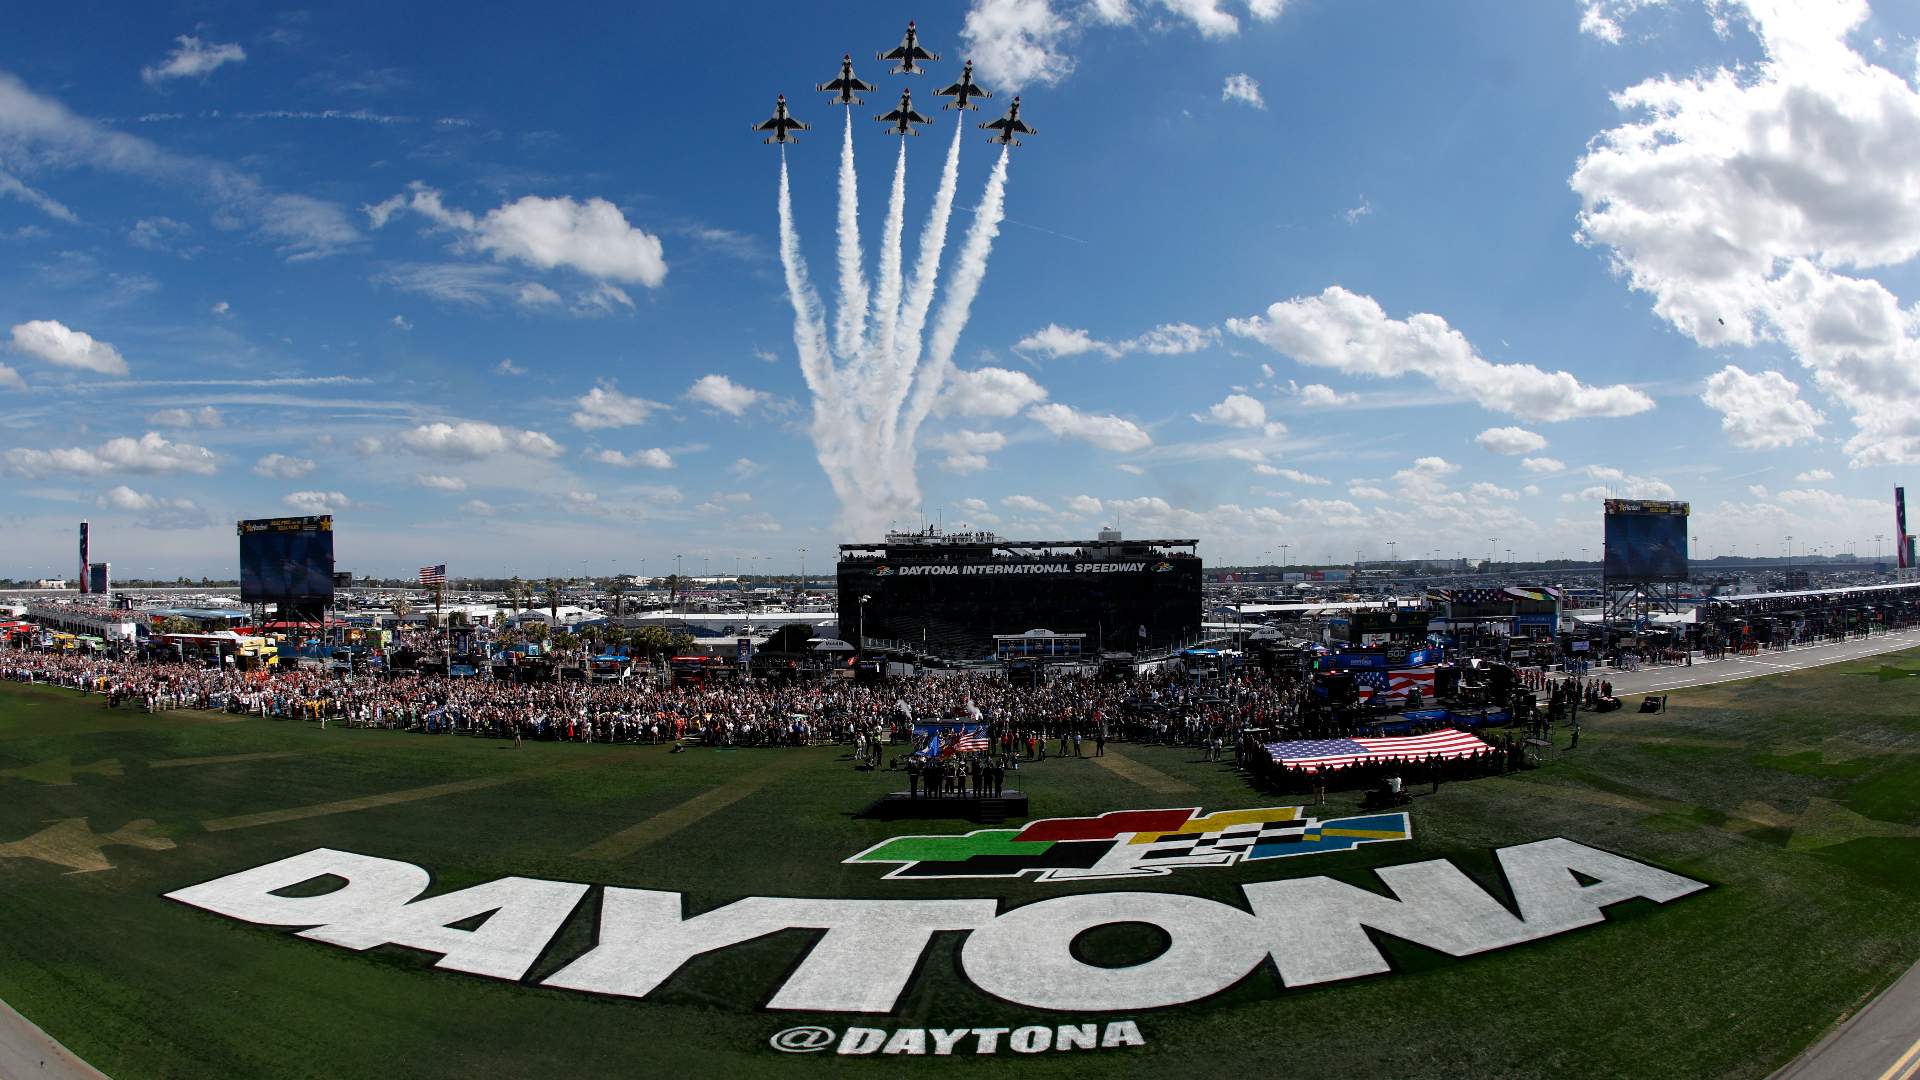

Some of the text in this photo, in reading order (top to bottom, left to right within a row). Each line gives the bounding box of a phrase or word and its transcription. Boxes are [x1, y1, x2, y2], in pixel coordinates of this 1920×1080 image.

[899, 562, 1146, 576] DAYTONA INTERNATIONAL SPEEDWAY
[164, 838, 1708, 1013] DAYTONA
[769, 1020, 1146, 1055] @DAYTONA
